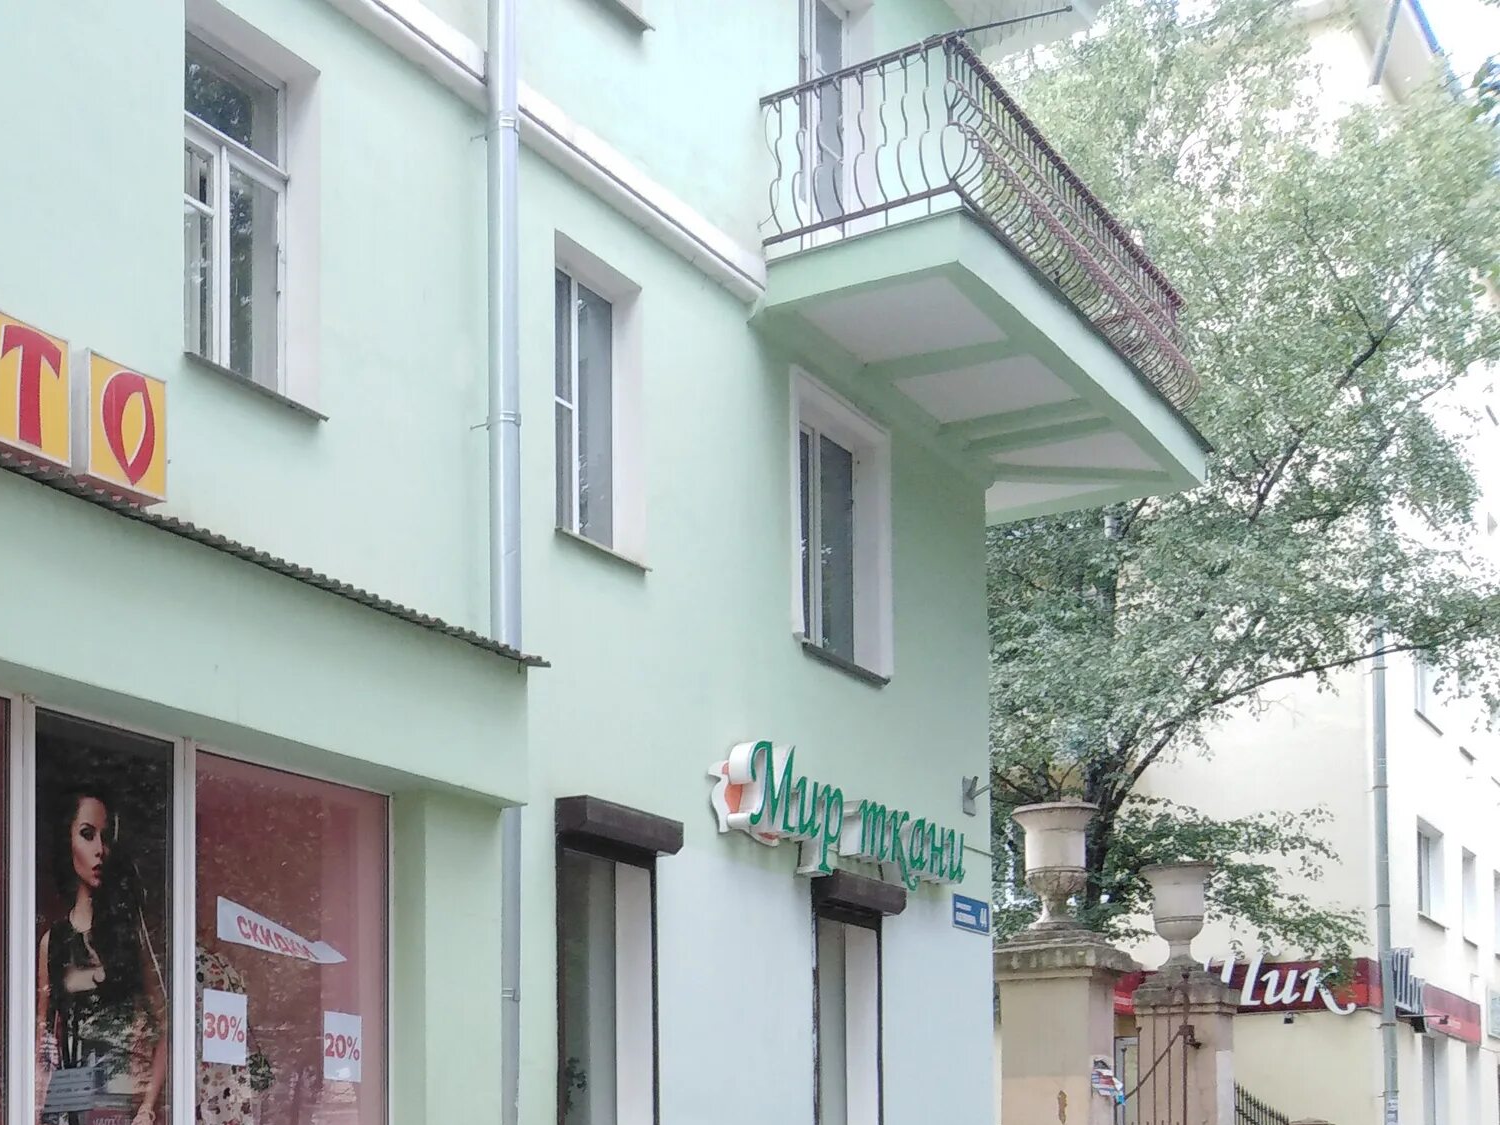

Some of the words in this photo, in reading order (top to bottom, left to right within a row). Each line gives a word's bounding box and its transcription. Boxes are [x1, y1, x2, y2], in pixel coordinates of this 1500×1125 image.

[749, 741, 844, 873] Мир
[859, 799, 966, 891] ткани
[203, 1012, 245, 1043] 30%
[324, 1032, 360, 1062] 20%
